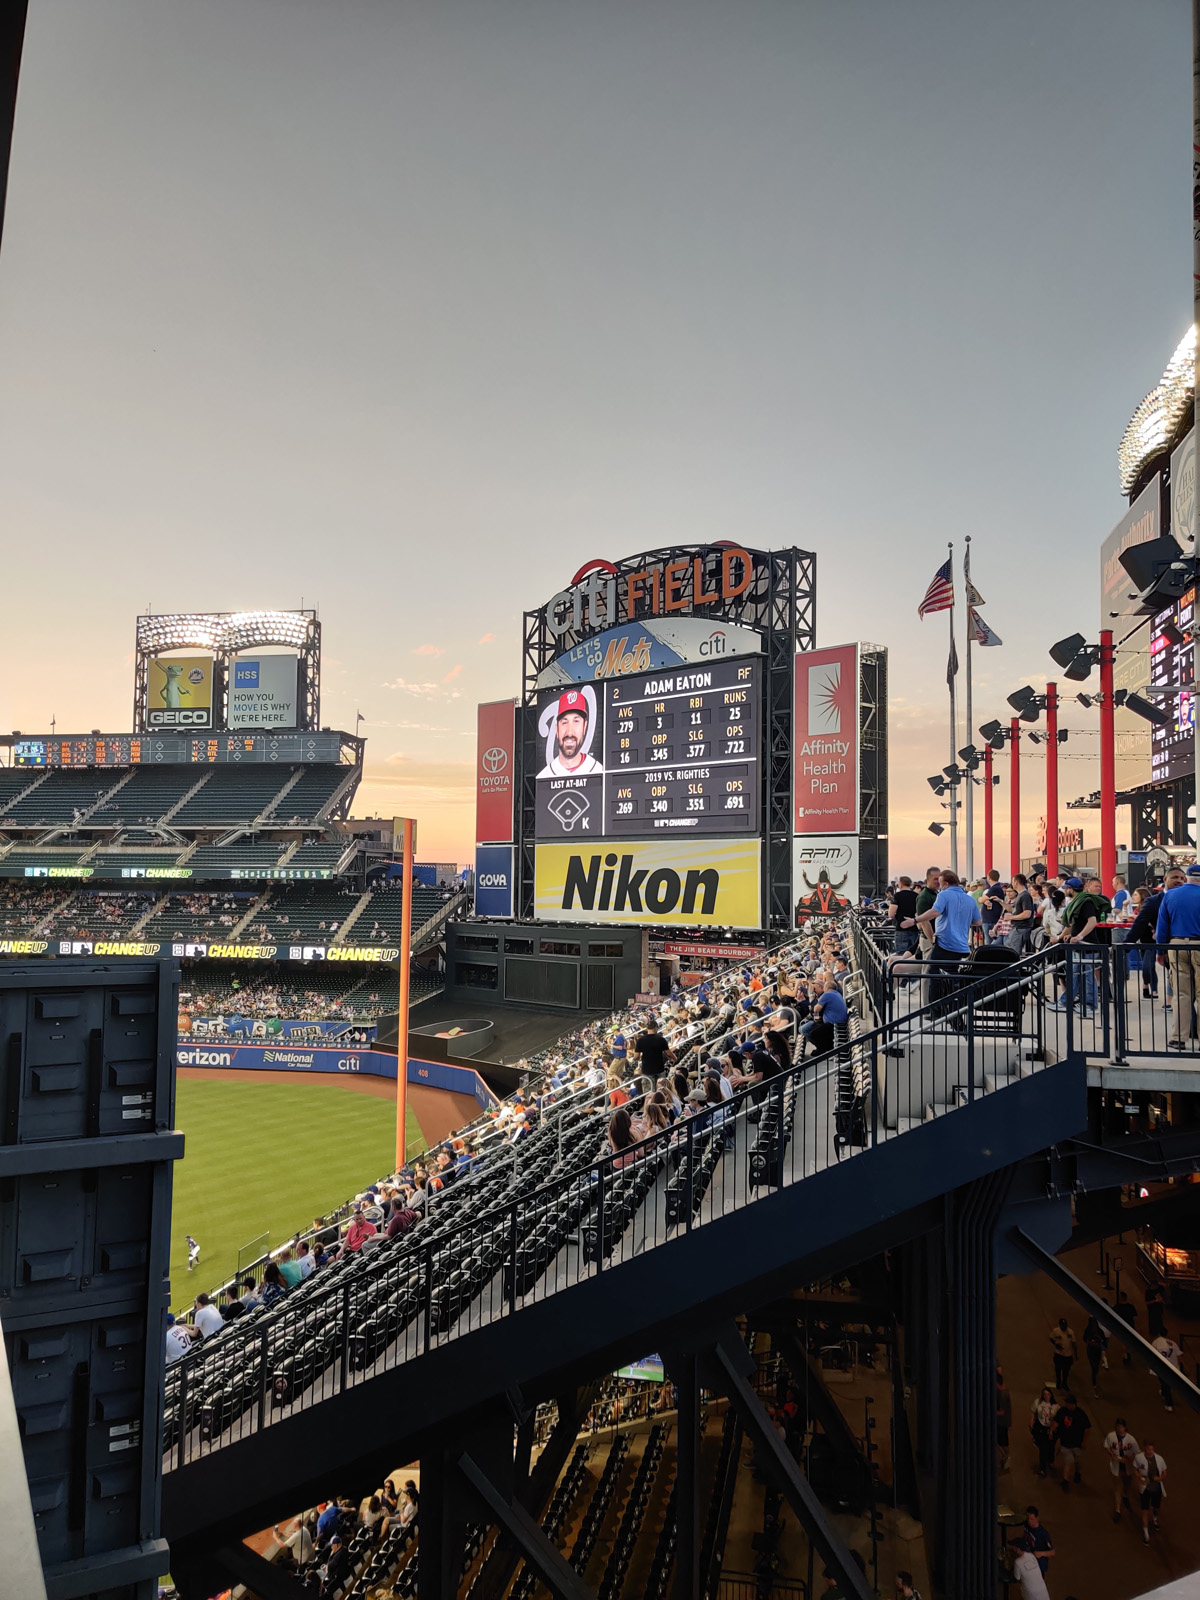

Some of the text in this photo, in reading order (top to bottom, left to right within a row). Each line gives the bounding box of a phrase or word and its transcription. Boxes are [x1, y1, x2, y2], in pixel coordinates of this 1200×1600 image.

[628, 549, 753, 618] FIELD
[570, 637, 601, 663] LET'S
[700, 635, 726, 656] citi
[587, 650, 603, 667] GO
[595, 636, 652, 679] Mets
[237, 671, 257, 680] HSS
[613, 667, 752, 699] 2 ADAM EATON RF
[234, 693, 274, 702] HOW YOU
[619, 691, 747, 718] AVG HR RBI RUNS
[234, 704, 258, 712] MOVE
[270, 703, 291, 711] WHY
[150, 711, 207, 724] GEICO
[233, 714, 287, 722] WE'RE HERE.
[617, 707, 740, 734] .279 3 11 25
[621, 726, 743, 748] BB OBP SLG OPS
[620, 740, 745, 764] 16 .345 .377 .722
[800, 739, 850, 757] Affinity
[803, 758, 846, 776] Health
[480, 776, 510, 786] TOYOTA
[645, 768, 710, 783] 2019 VS. RIGHTIES
[550, 779, 588, 789] LAST AT-BAT
[618, 781, 743, 799] AVG OBP SLG OPS
[811, 778, 838, 794] Plan
[616, 796, 744, 814] .269 .340 .351 .691
[804, 808, 822, 816] Affinity
[582, 817, 590, 829] K
[800, 848, 840, 858] RPM
[49, 868, 94, 877] CHANGEUP
[146, 869, 193, 878] CHANGEUP
[479, 873, 508, 886] GOYA
[562, 853, 719, 914] Nikon
[94, 942, 160, 955] CHANGEUP
[208, 944, 277, 958] CHANGEUP
[327, 947, 399, 961] CHANGEUP
[719, 949, 751, 957] BOURBON
[177, 1048, 230, 1066] erizon
[275, 1052, 313, 1063] National
[338, 1057, 359, 1070] citi
[418, 1068, 429, 1078] 408
